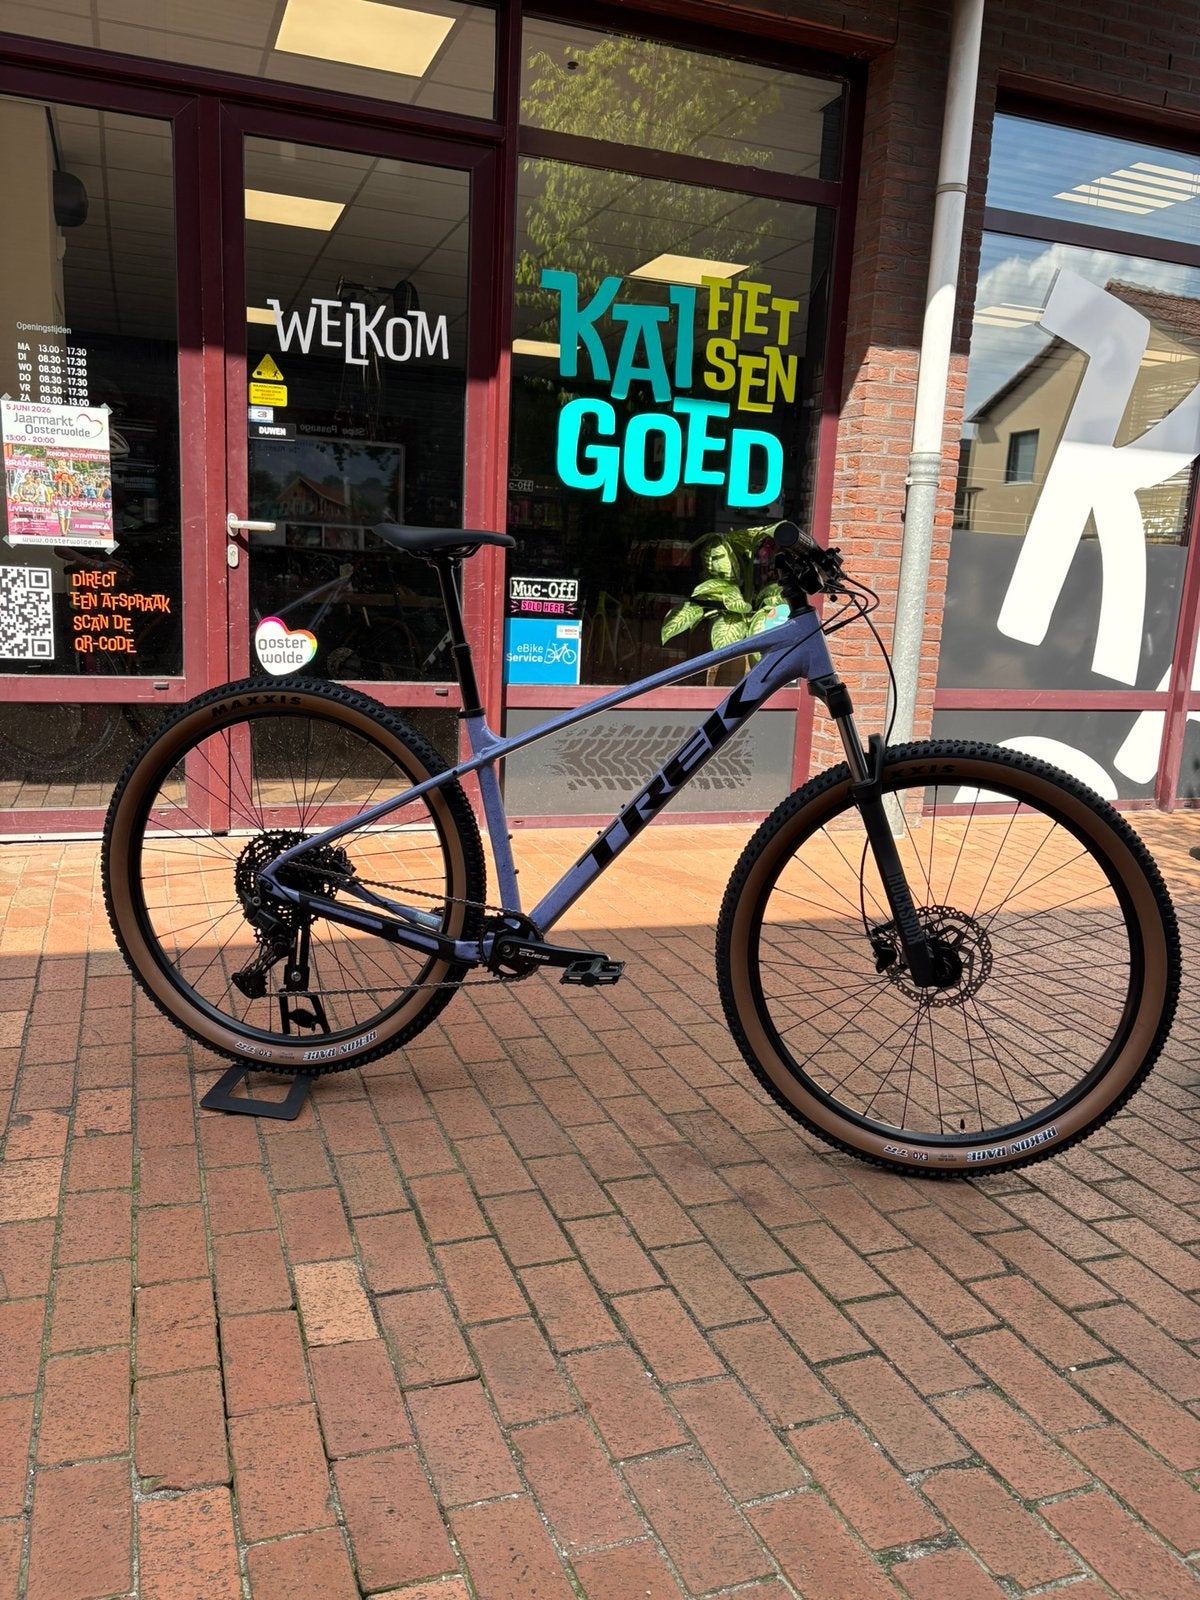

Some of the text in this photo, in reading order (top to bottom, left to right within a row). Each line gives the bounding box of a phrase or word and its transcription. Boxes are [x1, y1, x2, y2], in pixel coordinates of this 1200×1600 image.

[16, 321, 72, 335] Openingstijden
[266, 298, 450, 366] WELKOM
[541, 268, 800, 403] KAI FIET
[17, 342, 31, 351] MA
[38, 344, 60, 353] 13.00
[66, 346, 87, 356] 17.30
[18, 352, 27, 361] DI
[38, 354, 61, 364] 08.30
[66, 357, 87, 366] 17.30
[18, 362, 32, 371] WO
[38, 364, 61, 374] 08.30
[67, 367, 87, 376] 17.30
[703, 337, 798, 413] SEN
[19, 373, 31, 381] DO
[39, 375, 62, 384] 08.30
[67, 377, 88, 387] 17.30
[19, 383, 31, 392] VR
[40, 385, 62, 394] 08.30
[68, 387, 88, 397] 17.30
[20, 393, 31, 402] ZA
[40, 395, 63, 405] 09.00
[68, 397, 90, 407] 13.00
[5, 403, 52, 414] 5 JUNI 2026
[14, 412, 74, 427] Jaarmarkt
[25, 424, 91, 438] Oosterwolde
[258, 425, 287, 437] DUWEN
[5, 434, 27, 442] 13:00
[33, 436, 55, 444] 20:00
[557, 397, 784, 508] GOED
[5, 459, 46, 467] BRADERIE
[22, 536, 102, 546] www.oosterwolde.nl
[72, 570, 118, 589] DIRECT
[512, 580, 577, 599] Muc-Off
[70, 591, 172, 614] EEN AFSPRAAK
[521, 601, 565, 613] SOLD HERE
[73, 614, 134, 633] SCAN DE
[74, 634, 138, 653] QR-CODE
[517, 644, 544, 653] eBike
[261, 651, 304, 664] wolde
[506, 652, 544, 663] Service
[211, 695, 302, 718] MAXXIS
[577, 677, 758, 869] TREK
[891, 764, 957, 779] XXIS
[966, 1126, 1058, 1163] REKON RACE
[912, 1151, 929, 1161] EXO
